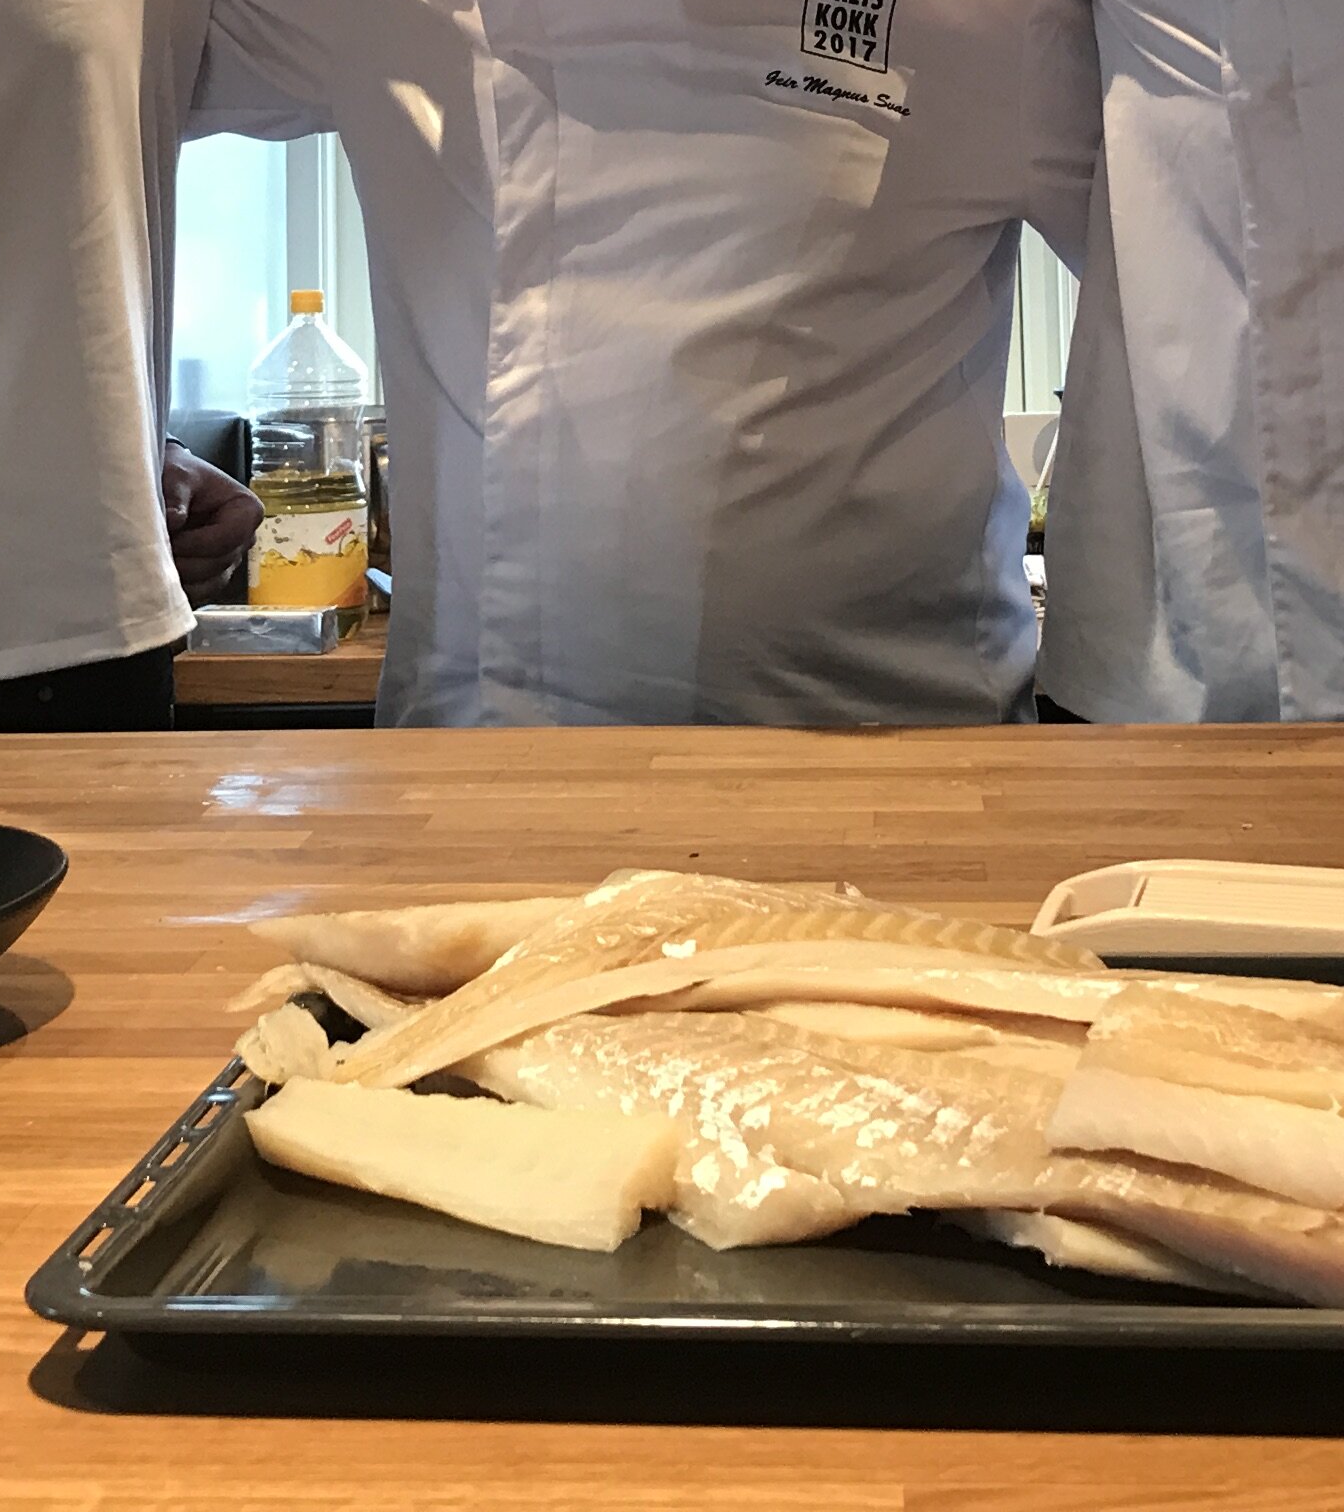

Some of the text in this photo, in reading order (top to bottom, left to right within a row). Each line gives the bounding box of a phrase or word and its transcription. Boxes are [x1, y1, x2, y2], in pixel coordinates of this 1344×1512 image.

[815, 3, 879, 38] KOKK
[814, 30, 877, 62] 2017
[803, 76, 869, 104] Magnus
